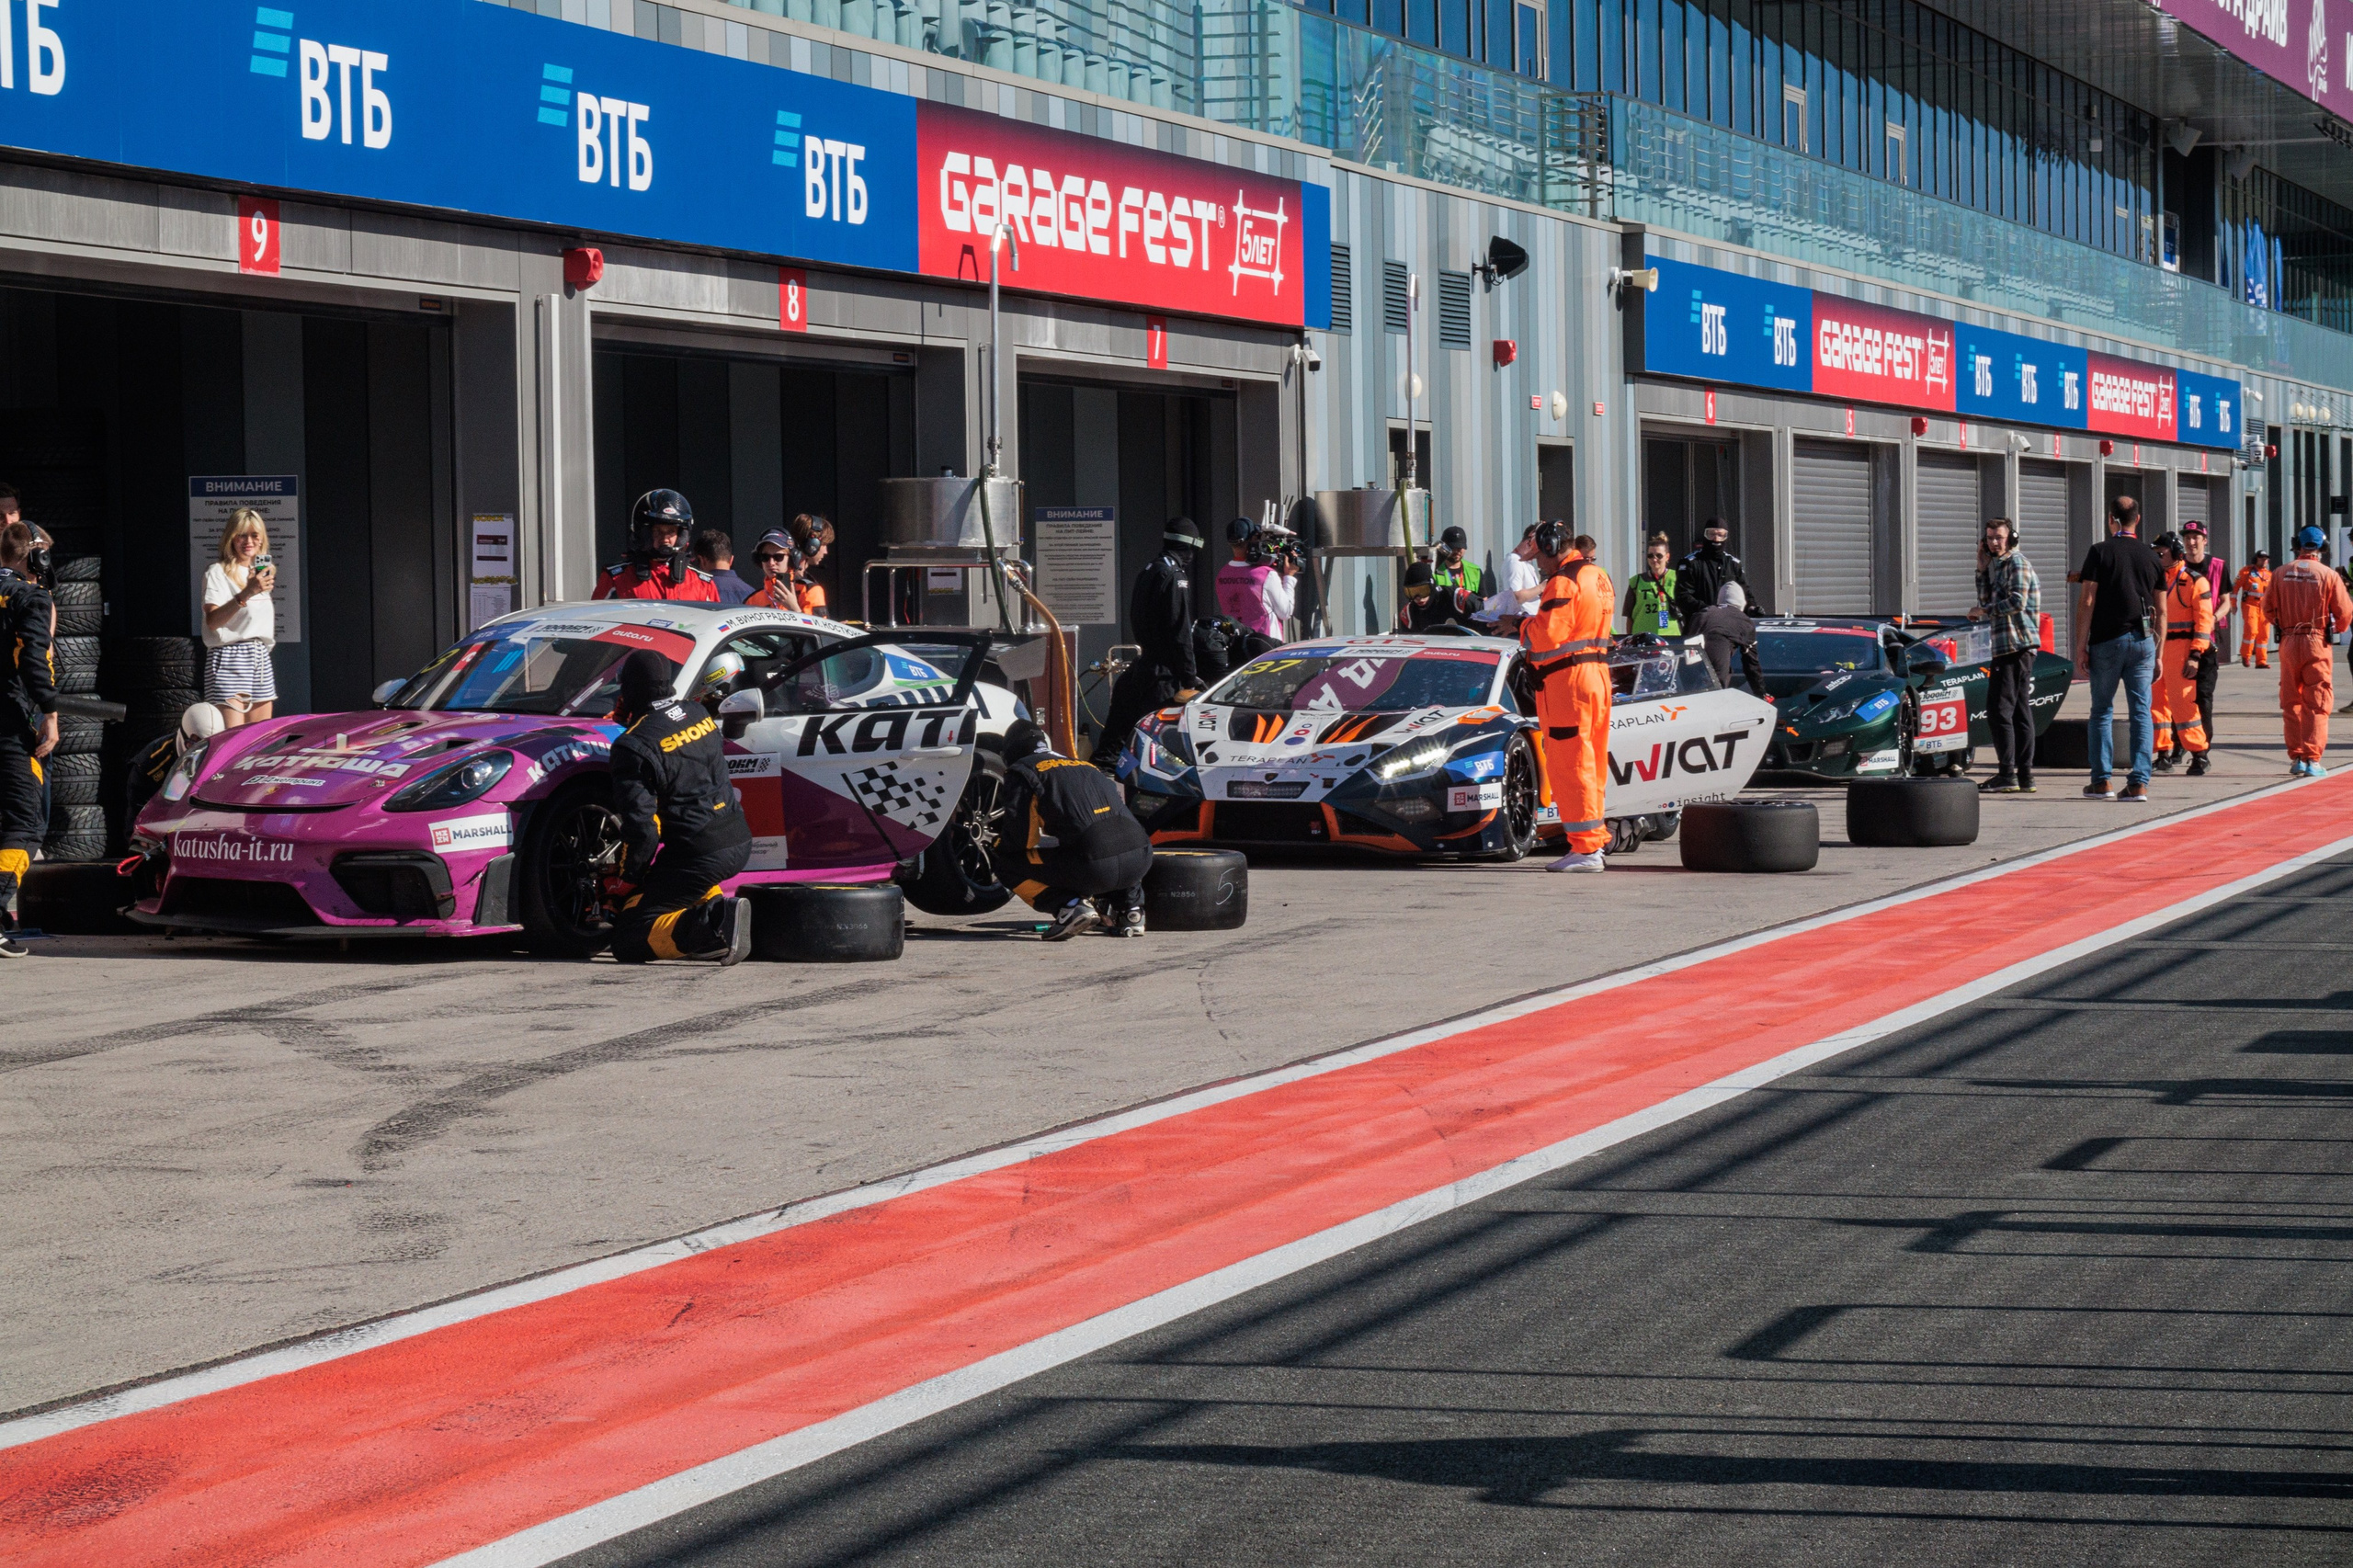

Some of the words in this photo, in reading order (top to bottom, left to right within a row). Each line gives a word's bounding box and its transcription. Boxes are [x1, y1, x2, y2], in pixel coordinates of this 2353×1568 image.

[0, 0, 65, 95] ТБ
[300, 39, 392, 149] ВТБ
[577, 92, 653, 192] ВТБ
[804, 135, 869, 225] ВТБ
[251, 210, 267, 262] 9
[788, 278, 799, 322] 8
[1152, 324, 1162, 358] 7
[1702, 303, 1727, 356] ВТБ
[1774, 317, 1796, 366] ВТБ
[1975, 355, 1992, 397] ВТБ
[2022, 364, 2037, 403] ВТБ
[2064, 371, 2079, 410] ВТБ
[1707, 393, 1714, 419] 6
[2189, 394, 2201, 428] ВТБ
[2220, 400, 2231, 432] ВТБ
[1847, 408, 1854, 432] 5
[206, 481, 282, 493] ВНИМАНИЕ
[1047, 510, 1103, 518] ВНИМАНИЕ
[1219, 576, 1256, 585] RODUCTION
[1645, 603, 1658, 614] 32
[613, 630, 654, 642] auto.ru
[910, 664, 928, 678] ВТБ
[1243, 659, 1302, 675] 37
[1940, 672, 1984, 687] TERAPLAN
[1873, 698, 1890, 710] ВТБ
[1608, 713, 1665, 730] RAPLAN
[1920, 707, 1957, 733] 93
[659, 717, 718, 752] SHONX
[1927, 739, 1943, 749] ВТБ
[1230, 756, 1308, 765] TERAPLAN
[1474, 759, 1495, 771] ВТБ
[1867, 756, 1896, 766] MARSHALL
[1467, 791, 1499, 801] MARSHALL
[452, 824, 512, 840] MARSHALL
[173, 831, 294, 863] katusha-it.ru
[1216, 868, 1235, 905] 5
